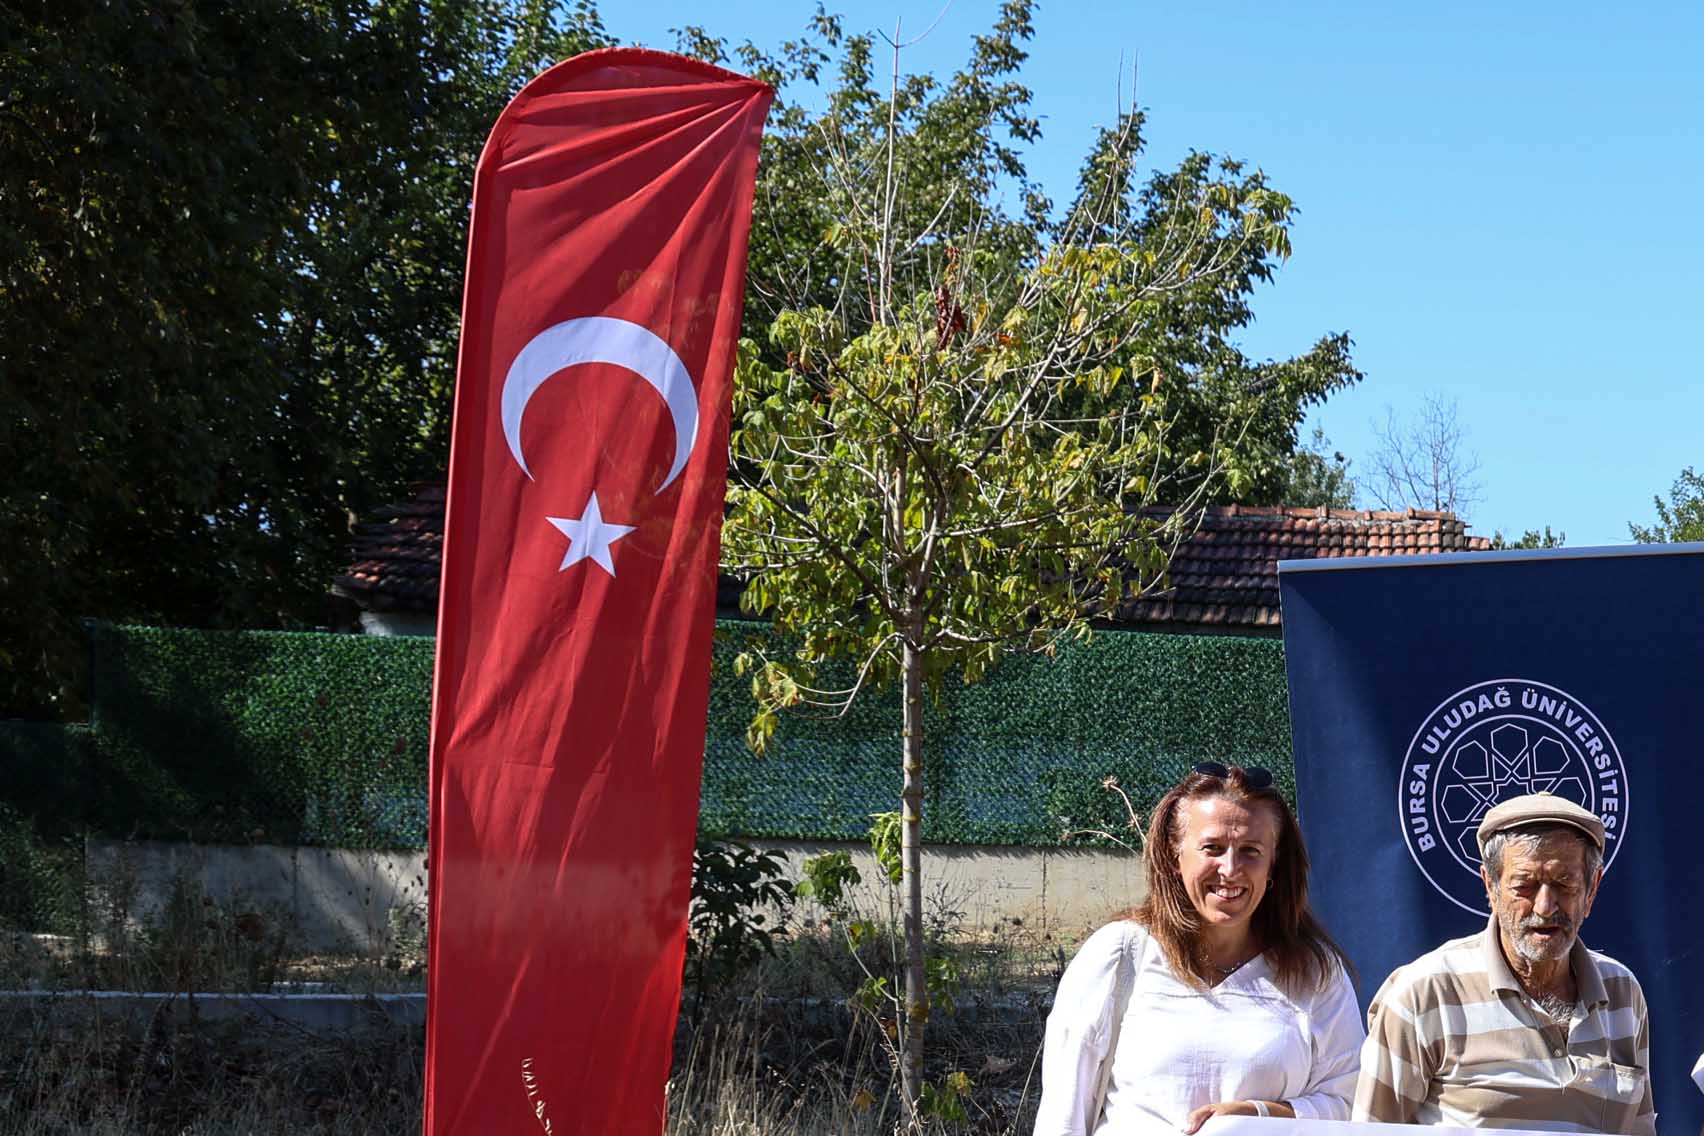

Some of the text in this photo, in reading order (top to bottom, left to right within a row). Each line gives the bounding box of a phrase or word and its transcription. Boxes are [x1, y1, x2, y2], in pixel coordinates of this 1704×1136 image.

[1409, 686, 1619, 853] BURSA ULUDAĞ ÜNİVERSİTESİ
